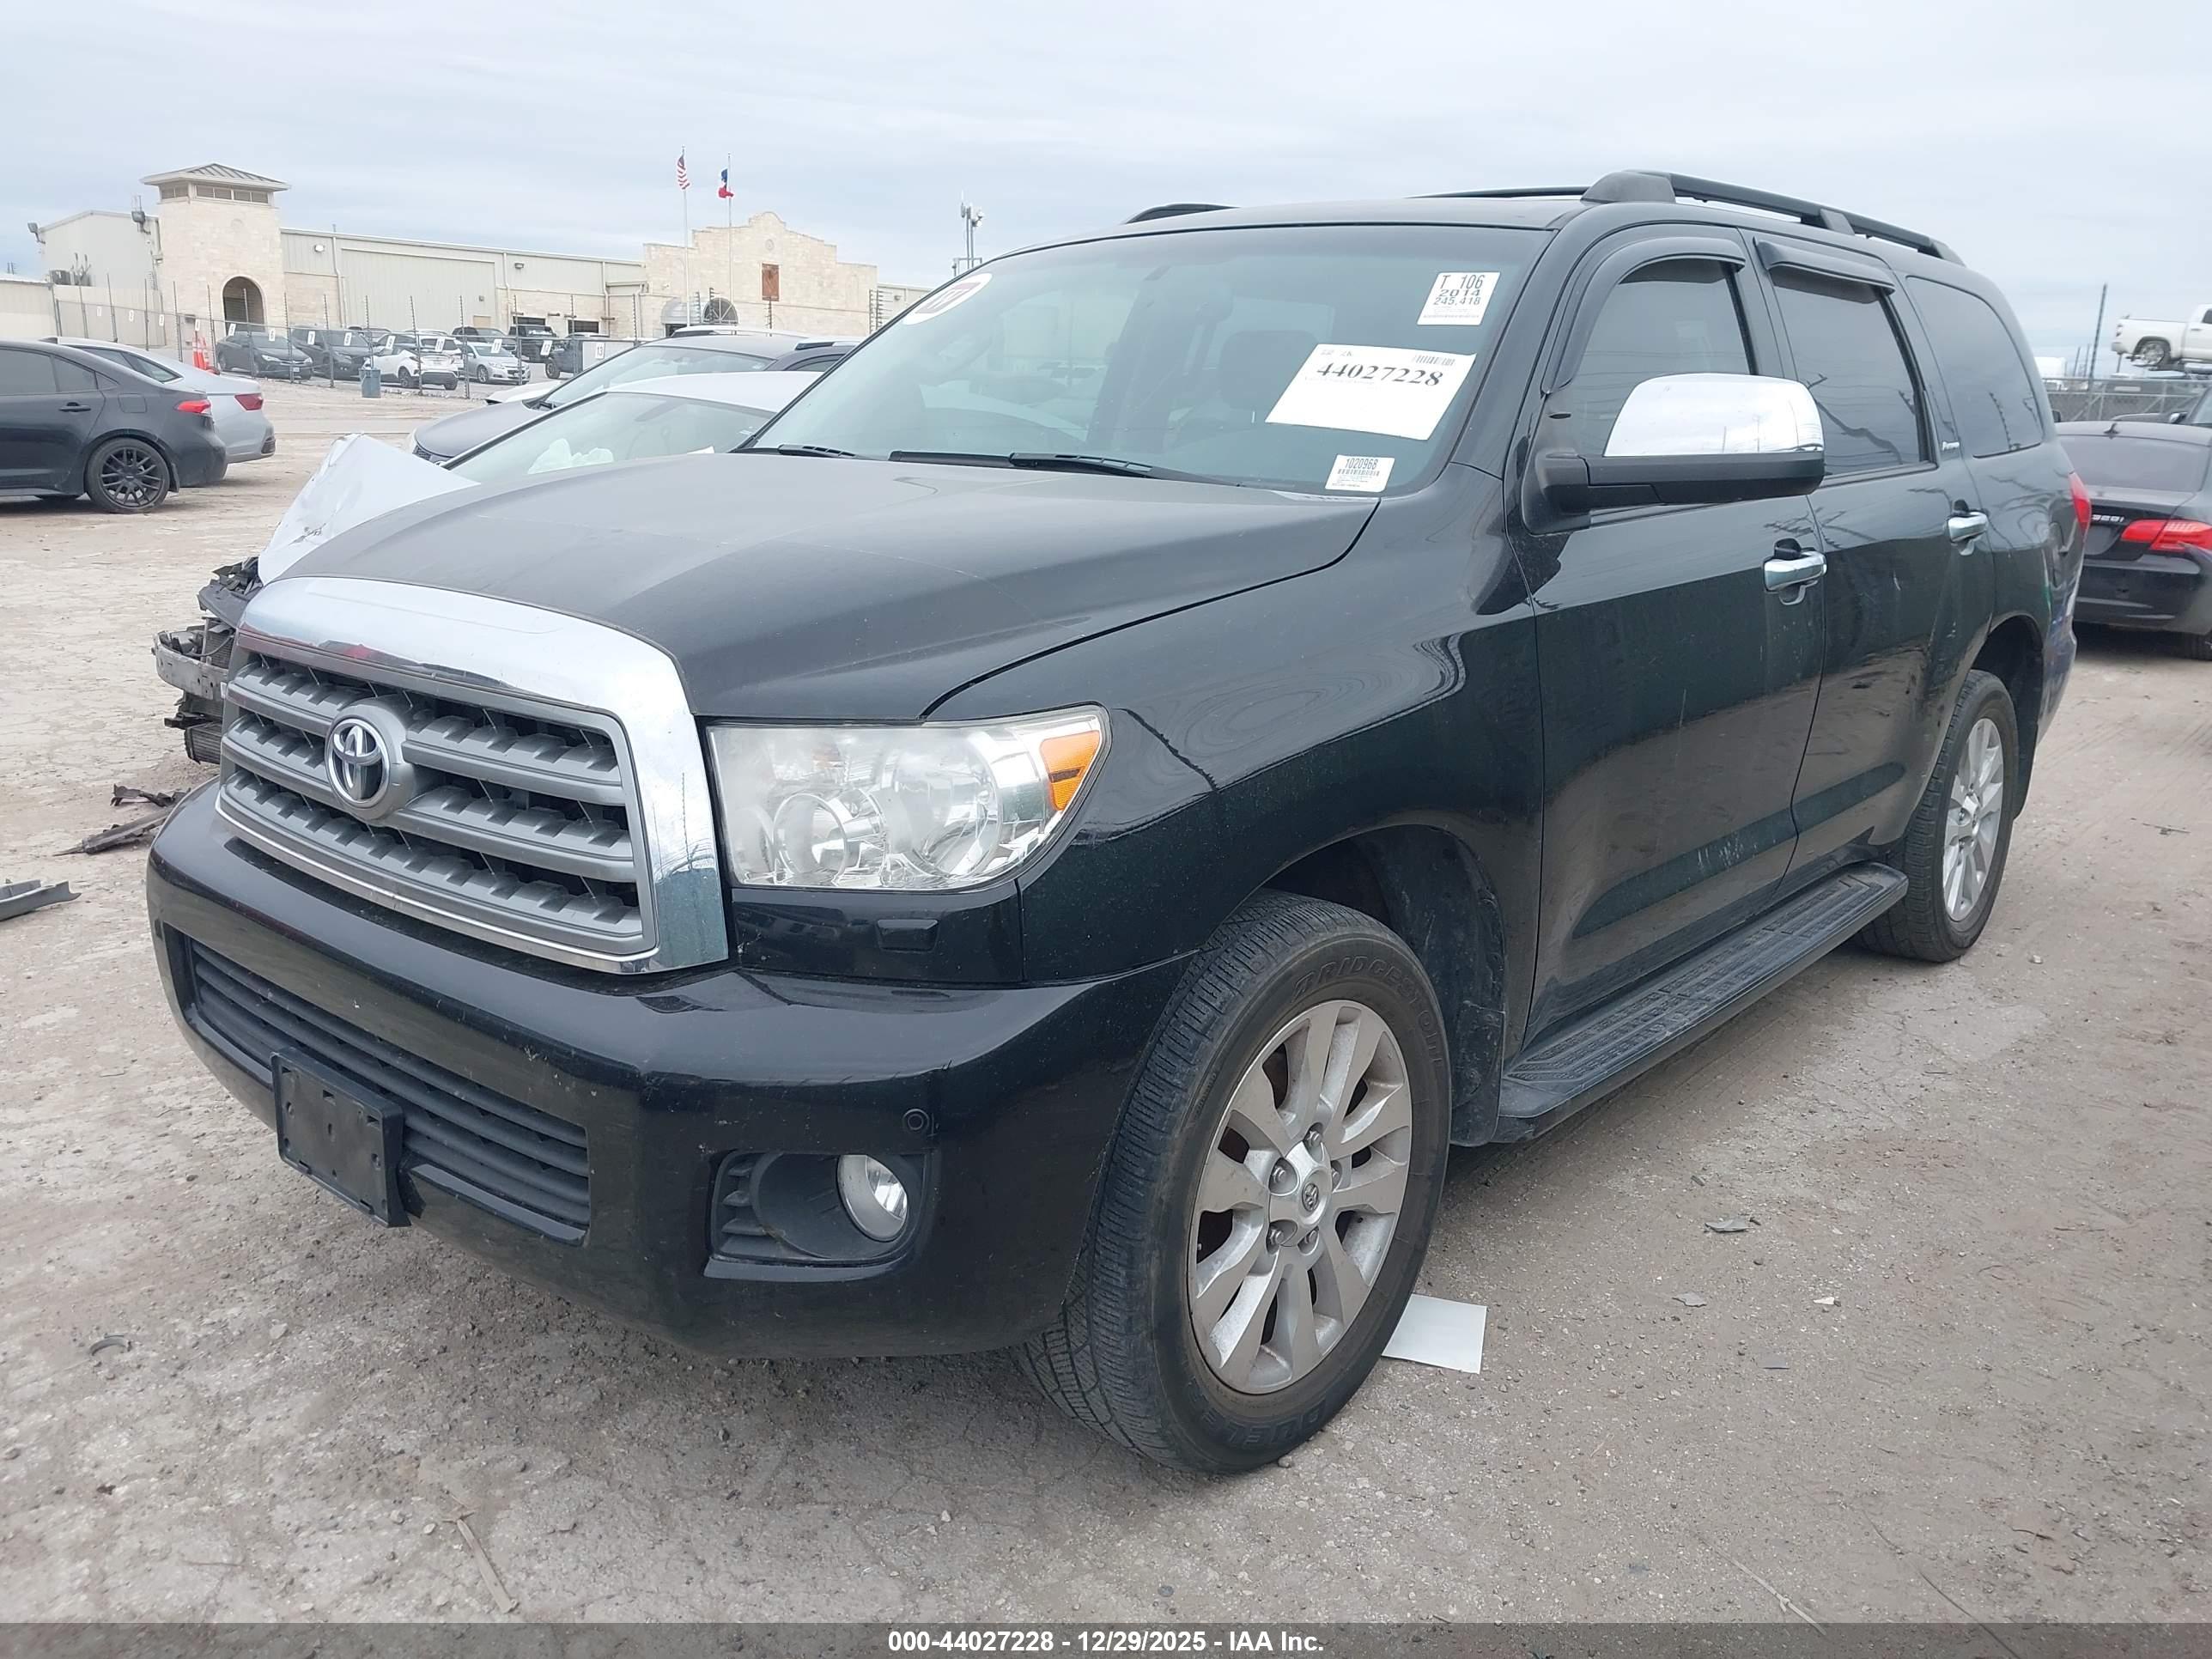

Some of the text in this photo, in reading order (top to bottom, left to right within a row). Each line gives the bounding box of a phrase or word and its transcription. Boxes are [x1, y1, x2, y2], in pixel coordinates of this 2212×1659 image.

[1440, 274, 1486, 289] T 106
[1438, 289, 1481, 297] 2014
[597, 346, 604, 356] 13
[1317, 362, 1443, 386] 44027228
